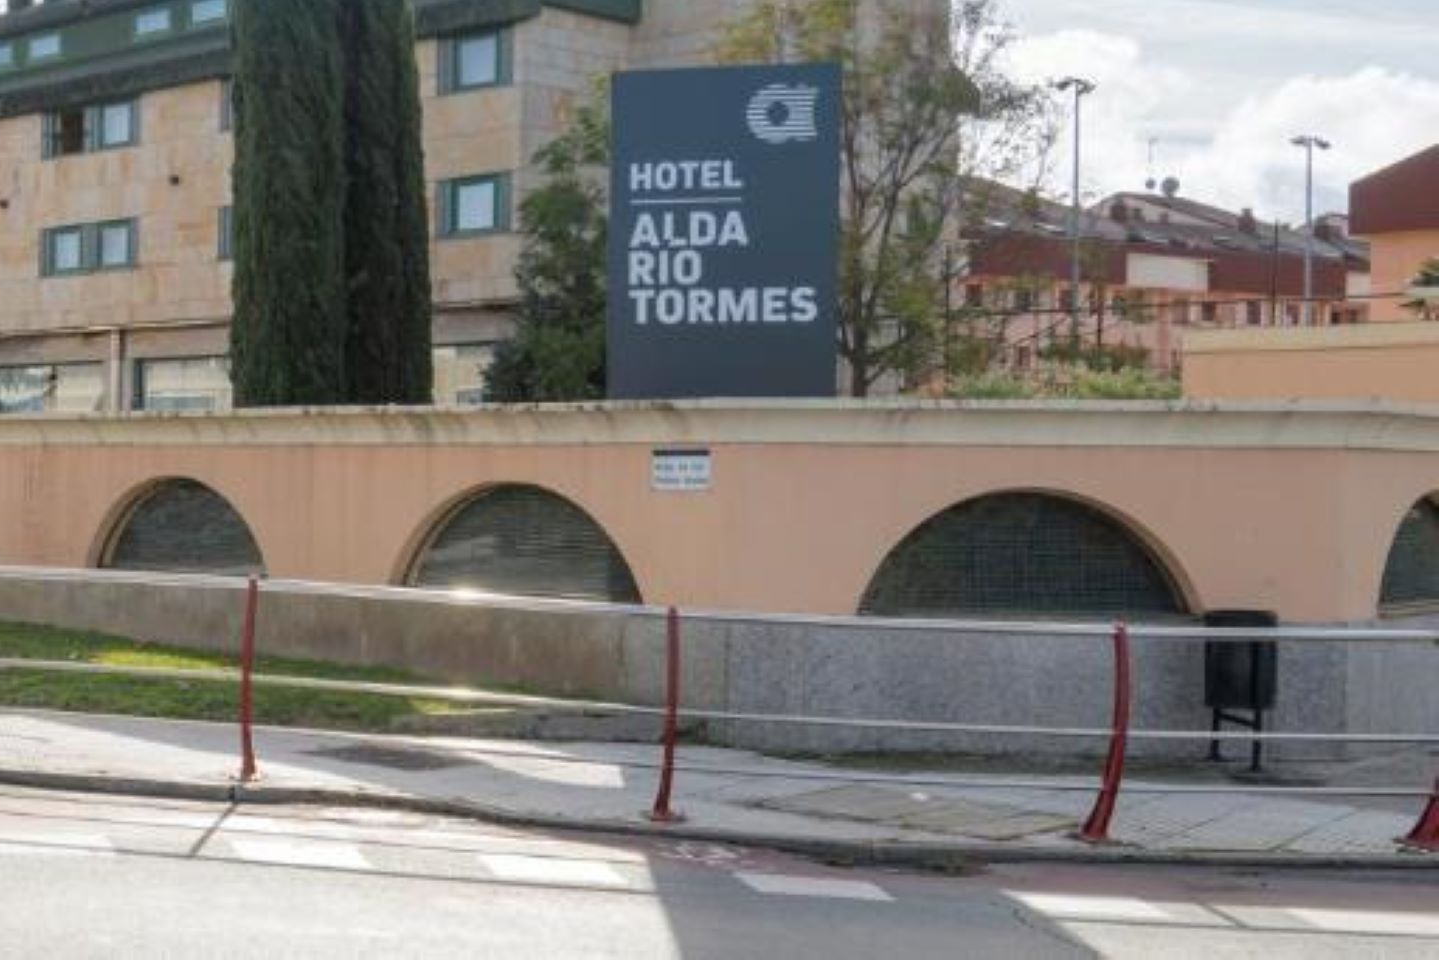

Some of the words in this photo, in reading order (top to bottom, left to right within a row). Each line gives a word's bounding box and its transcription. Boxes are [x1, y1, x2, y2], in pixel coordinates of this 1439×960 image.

[630, 159, 744, 191] HOTEL
[629, 210, 749, 249] ALDA
[628, 249, 703, 286] RIO
[628, 286, 819, 325] TORMES
